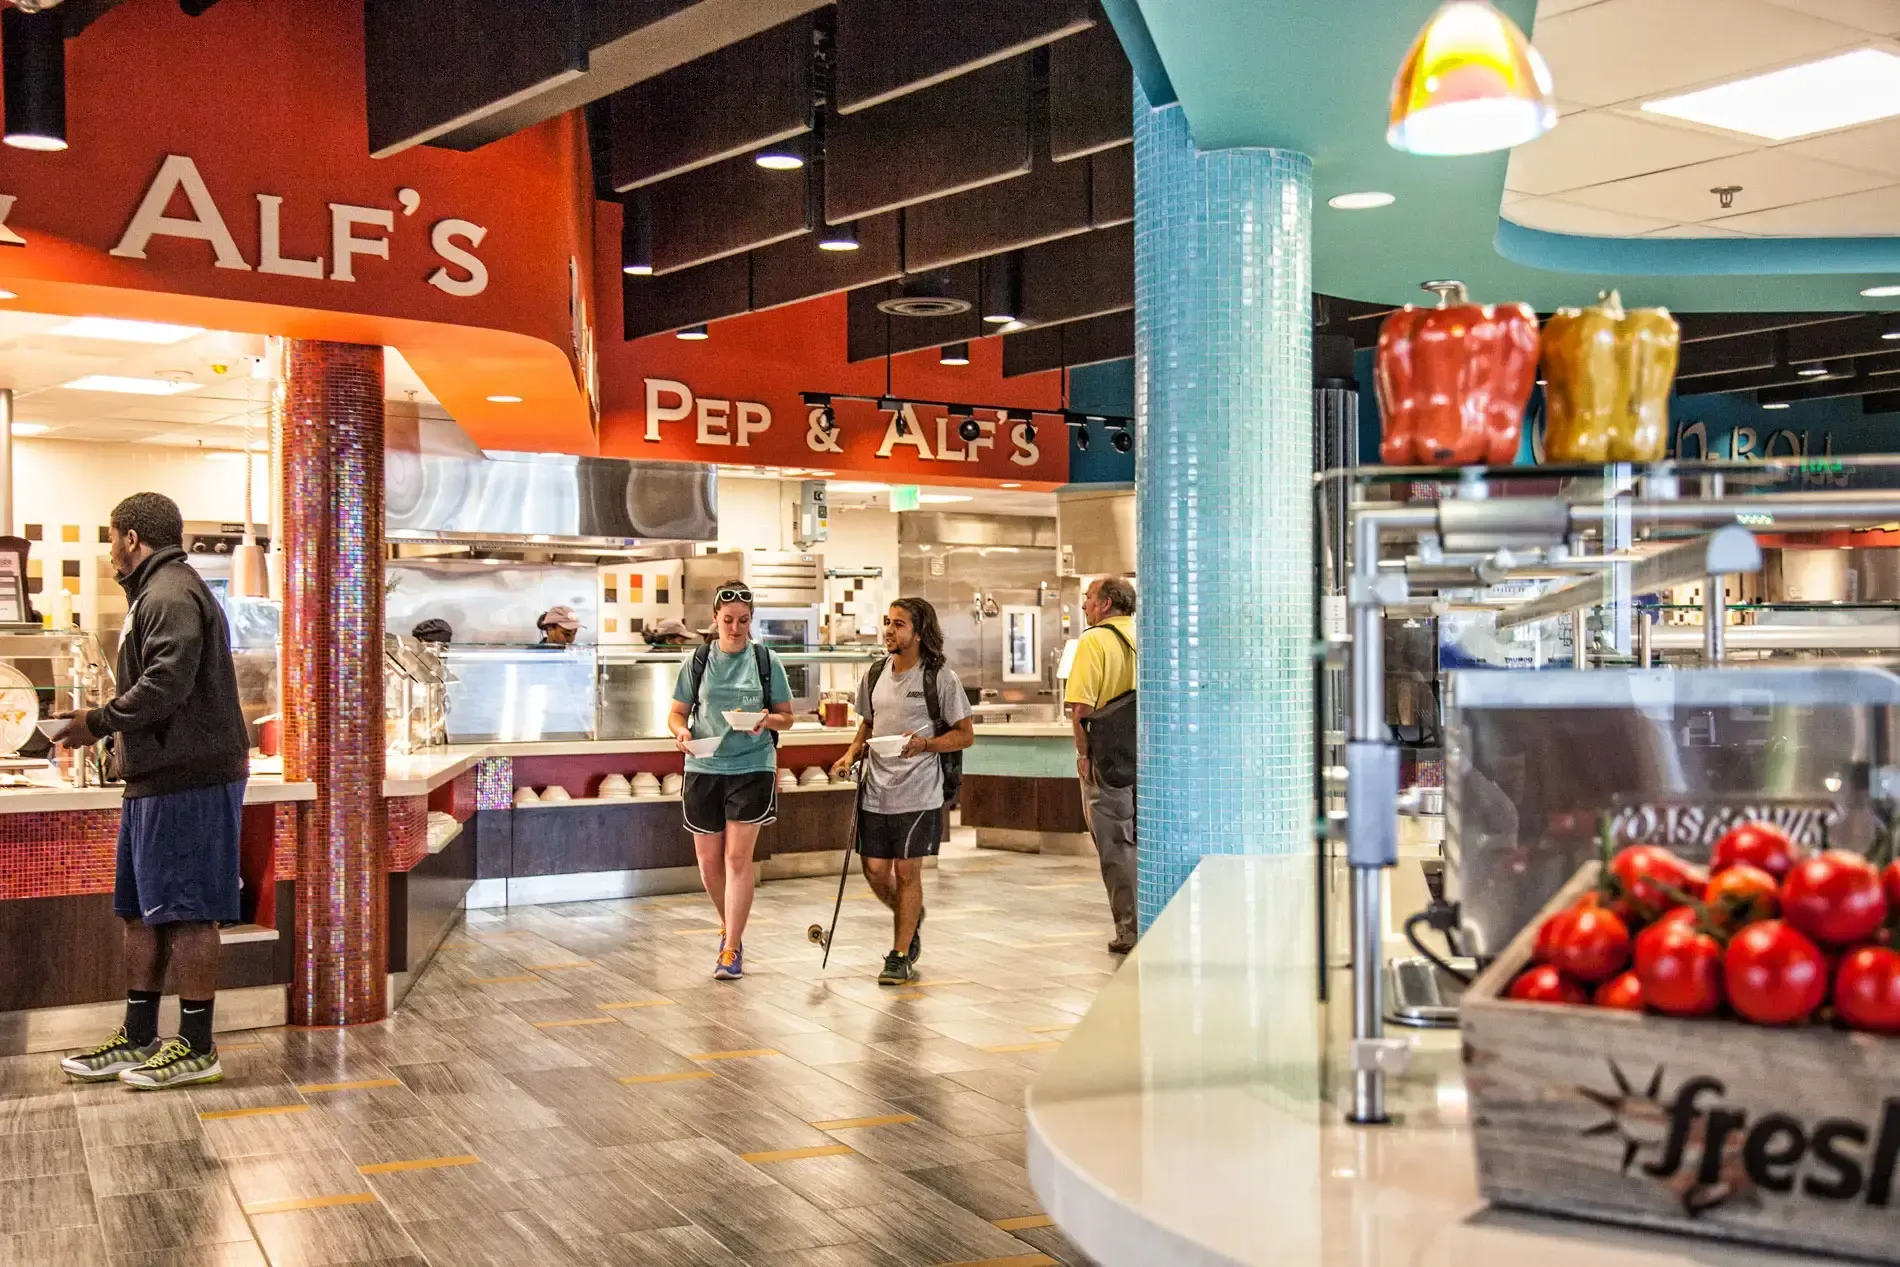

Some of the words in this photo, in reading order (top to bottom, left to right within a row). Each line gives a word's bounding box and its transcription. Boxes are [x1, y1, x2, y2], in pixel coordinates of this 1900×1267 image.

[109, 153, 489, 297] ALF'S
[643, 377, 772, 447] PEP
[806, 408, 844, 453] &
[875, 402, 1040, 467] ALF'S
